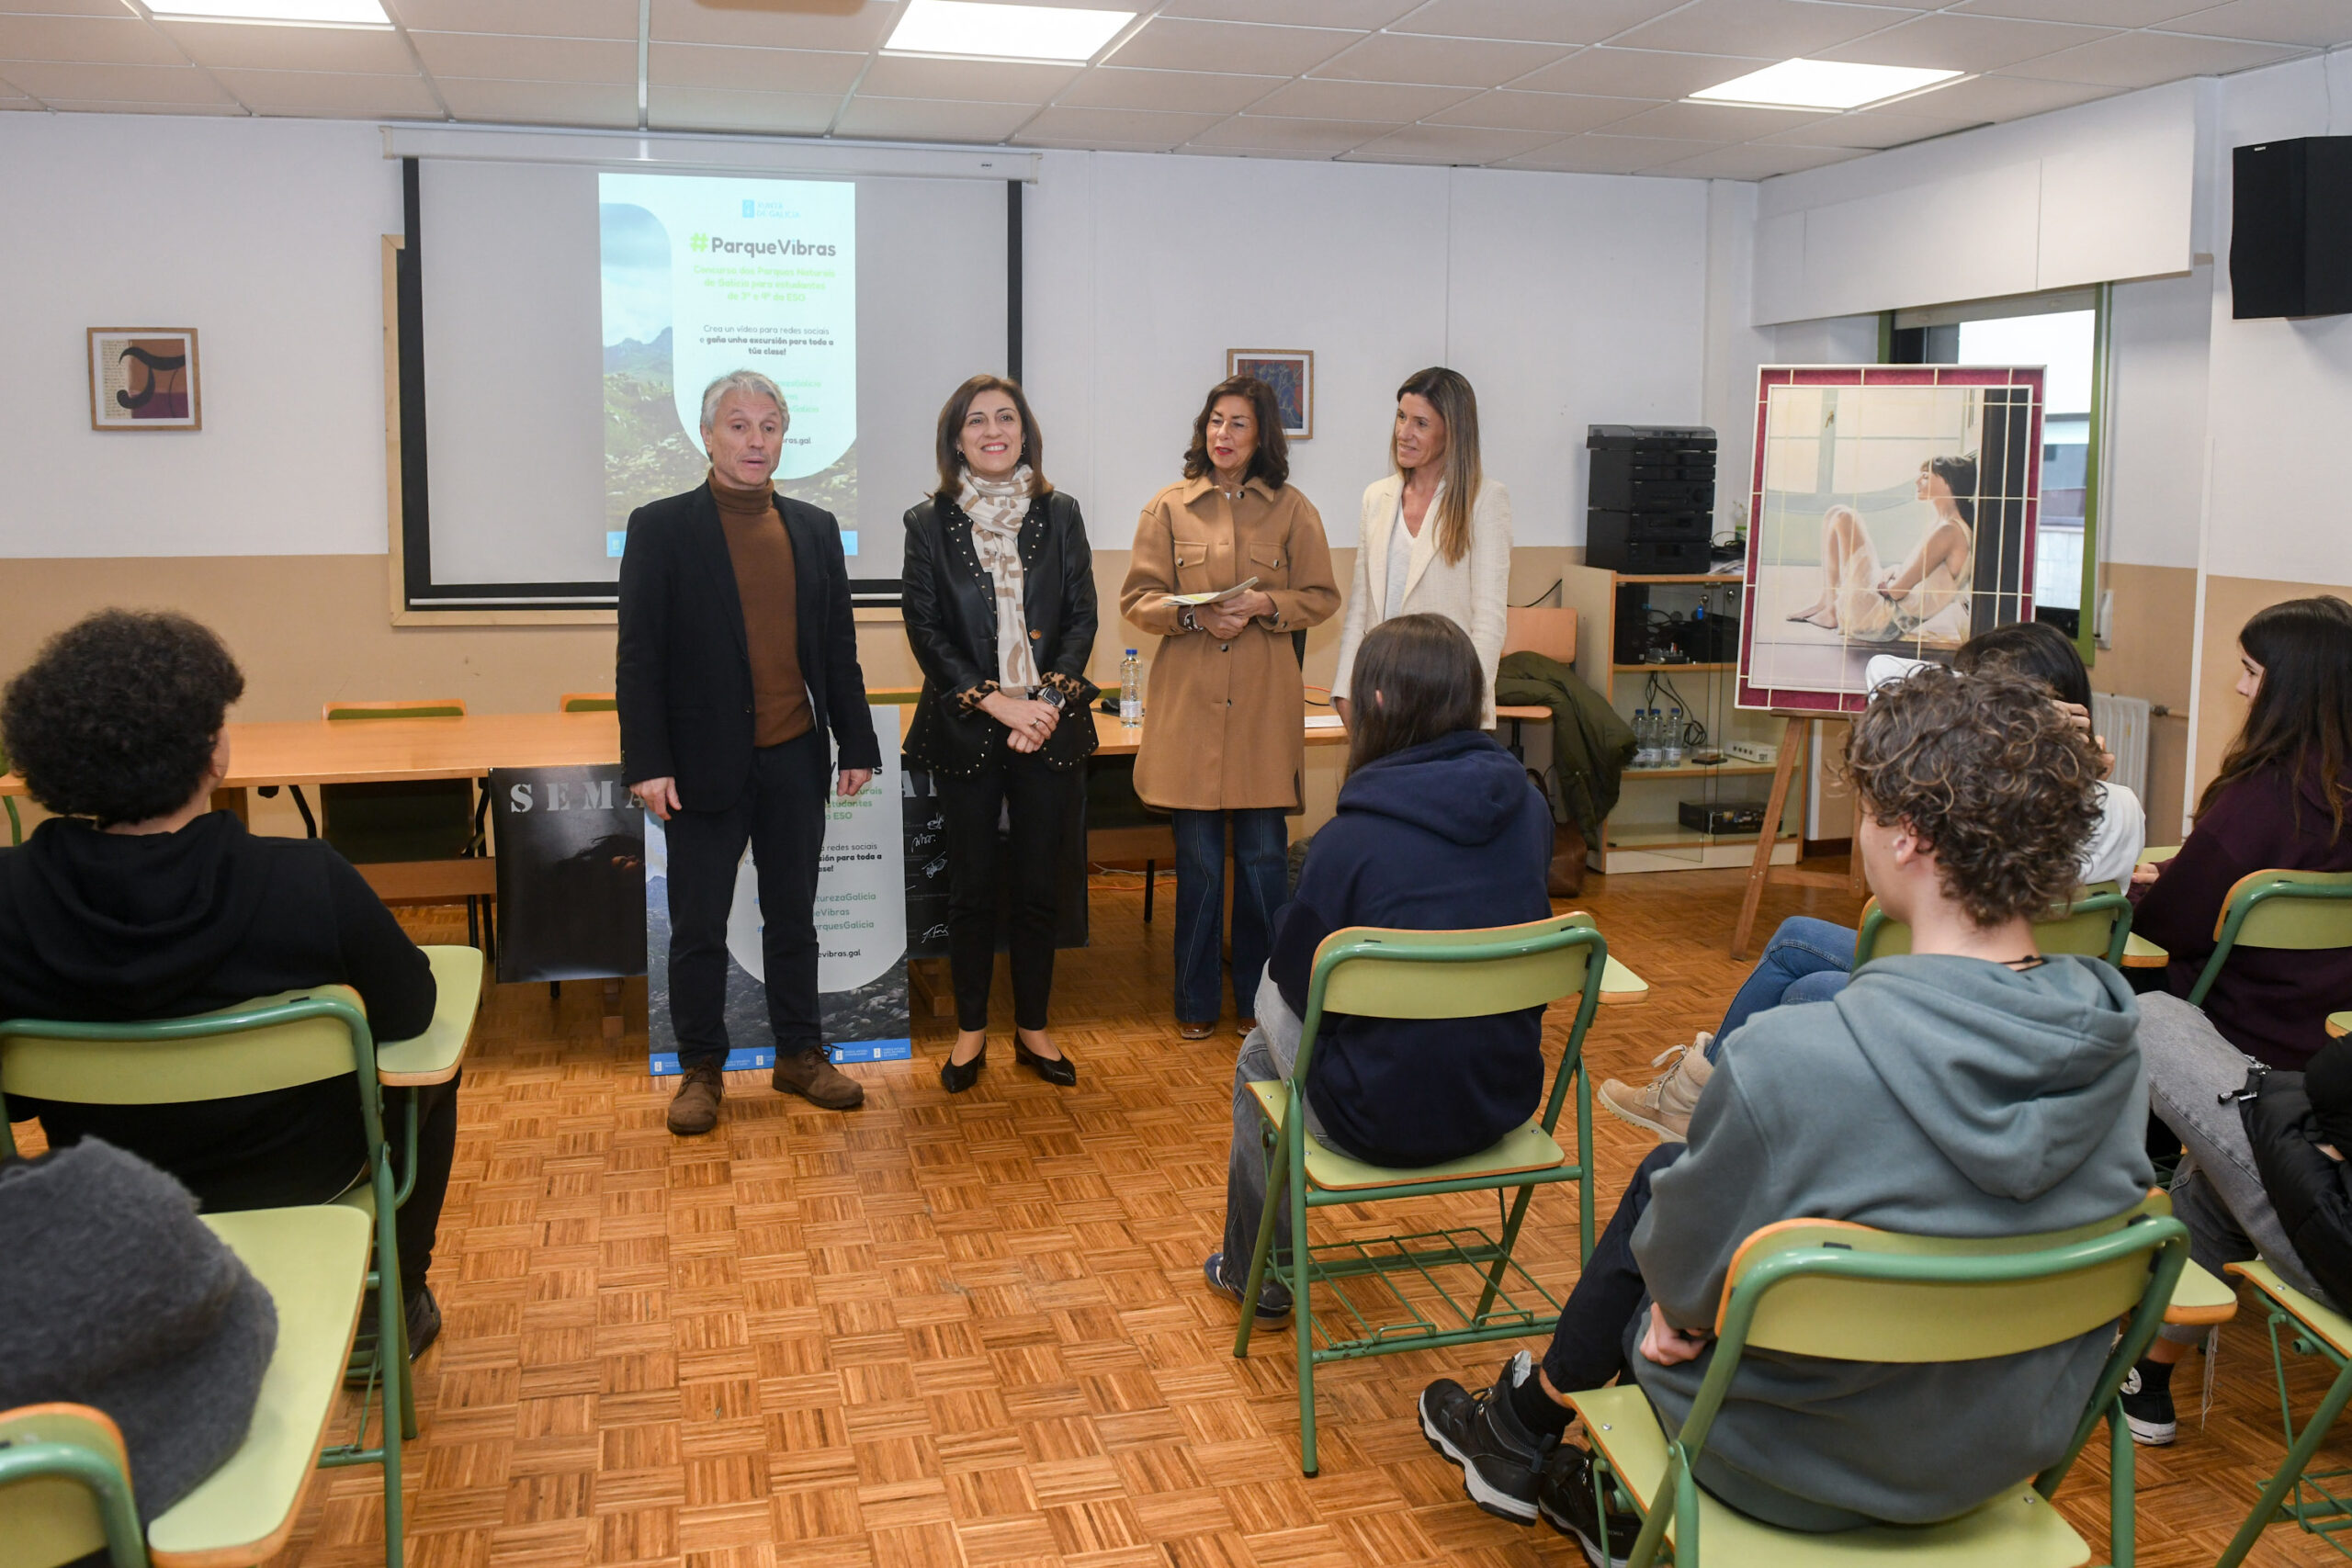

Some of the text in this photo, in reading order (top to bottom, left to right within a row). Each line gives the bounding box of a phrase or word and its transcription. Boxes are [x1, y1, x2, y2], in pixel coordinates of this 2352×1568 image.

[689, 232, 837, 258] #ParqueVibras
[694, 265, 737, 275] Concurso
[757, 266, 795, 277] Parques
[797, 267, 836, 277] Naturais
[704, 278, 826, 289] de Galicia para estudantes
[786, 293, 807, 301] ESO
[780, 326, 801, 334] redes
[707, 336, 726, 344] gaña
[749, 336, 787, 344] excursión
[789, 338, 807, 346] para
[833, 811, 853, 820] ESO
[827, 843, 850, 852] redes
[851, 842, 877, 851] sociais
[836, 854, 855, 863] para
[857, 852, 876, 861] toda
